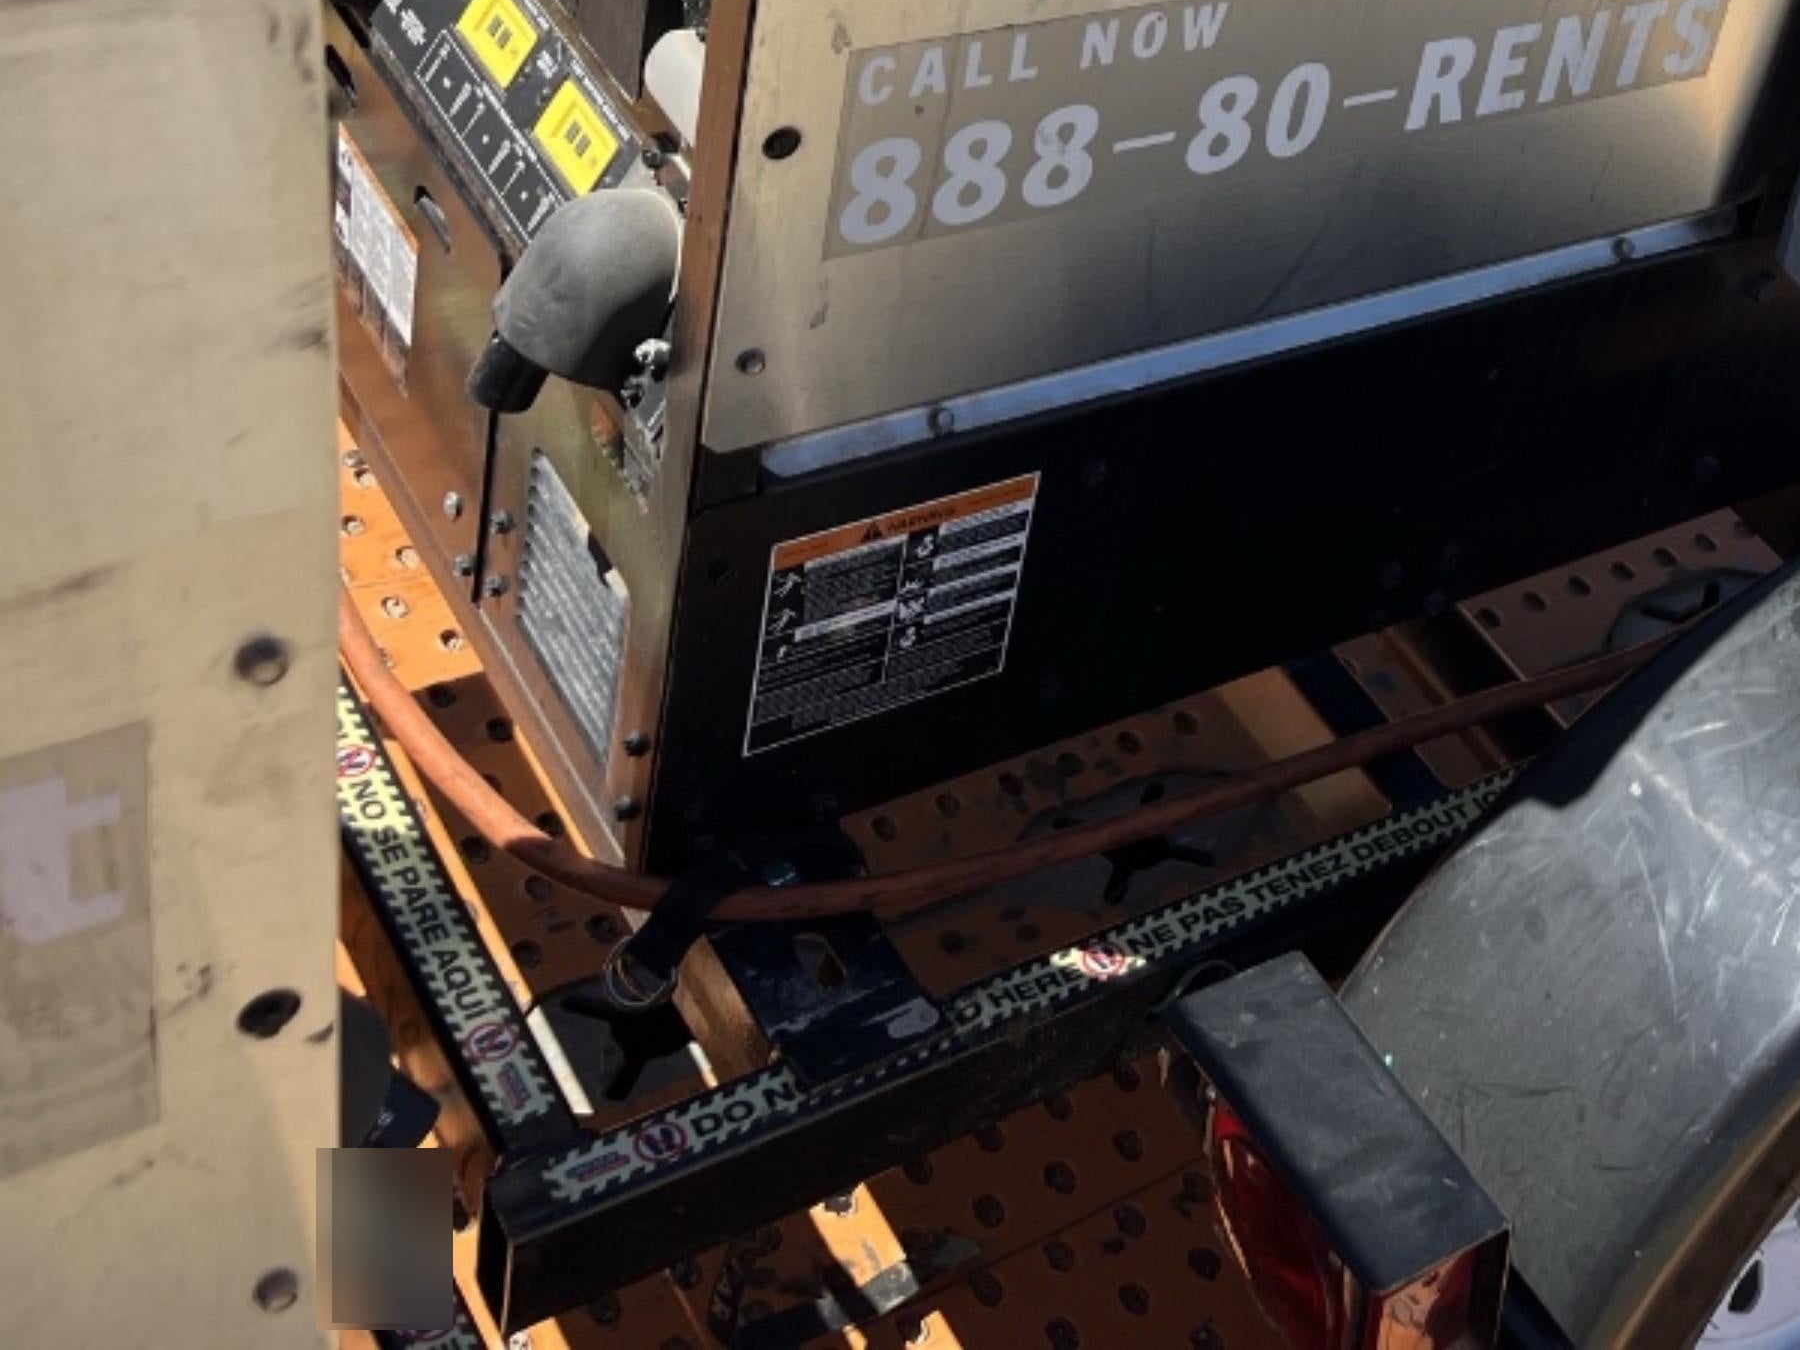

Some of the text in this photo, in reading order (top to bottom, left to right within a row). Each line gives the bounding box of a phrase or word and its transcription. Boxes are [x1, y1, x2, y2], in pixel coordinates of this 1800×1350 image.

[858, 1, 1231, 106] CALL NOW
[351, 780, 386, 822] NO
[372, 825, 408, 864] SE
[391, 865, 451, 945] PARE
[1177, 896, 1246, 933] PAS
[1244, 853, 1348, 904] TENEZ
[1352, 802, 1469, 862] DEBOUT
[987, 966, 1087, 1004] HERE
[690, 1100, 754, 1137] DO
